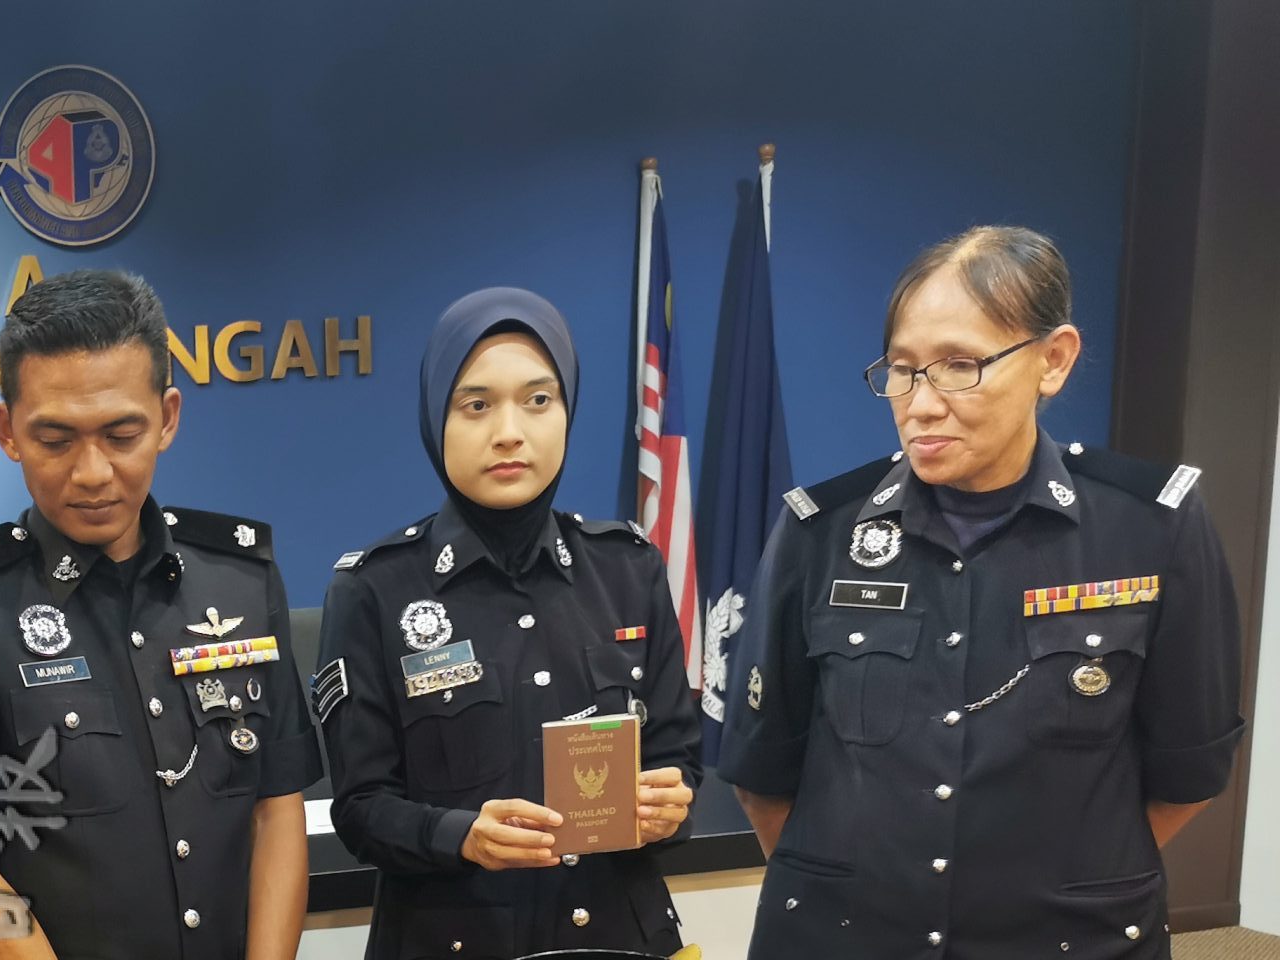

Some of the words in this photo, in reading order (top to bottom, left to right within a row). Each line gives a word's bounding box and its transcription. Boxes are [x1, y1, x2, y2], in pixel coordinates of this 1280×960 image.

[860, 589, 878, 600] TAN
[424, 652, 450, 665] LENNY
[35, 664, 76, 678] MUNAWIR
[568, 807, 617, 820] THAILAND
